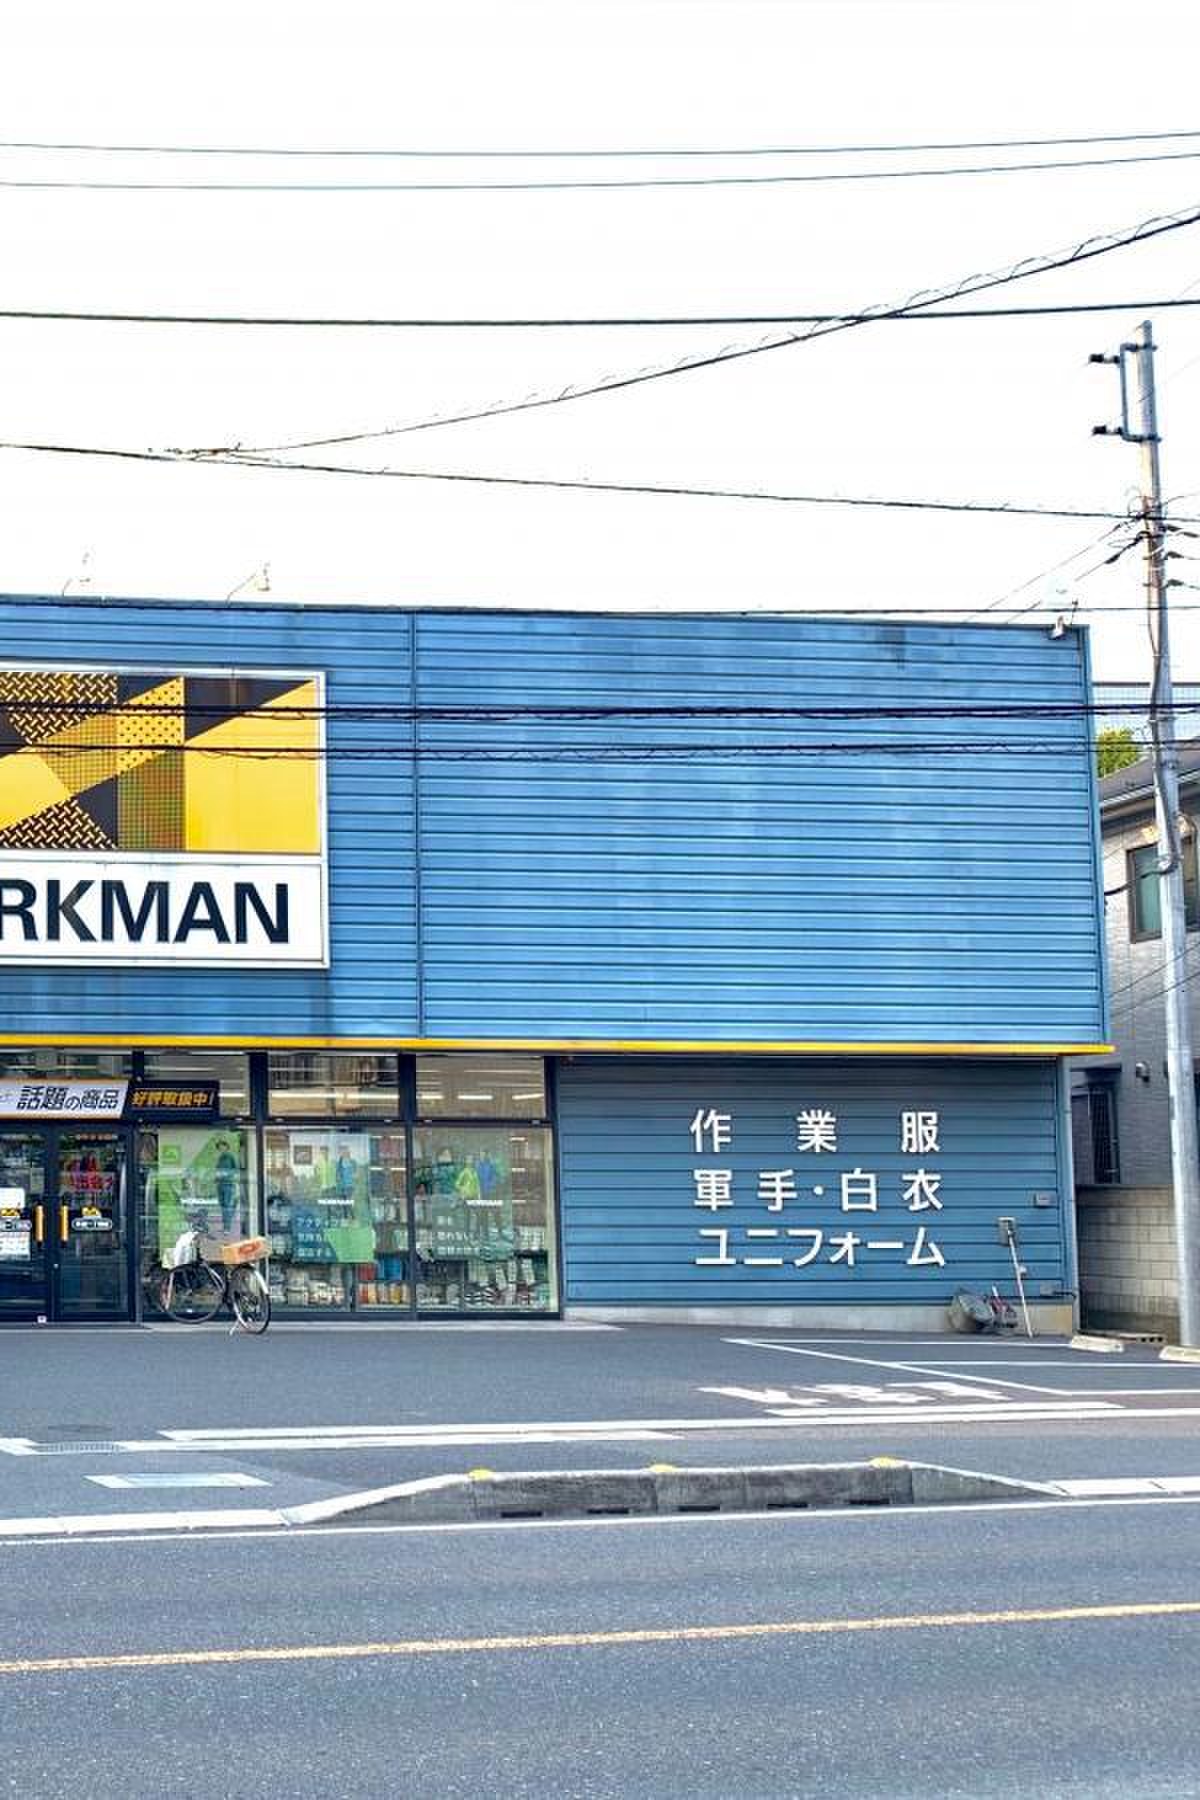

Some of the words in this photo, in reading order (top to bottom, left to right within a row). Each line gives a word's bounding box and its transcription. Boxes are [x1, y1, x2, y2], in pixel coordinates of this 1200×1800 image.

[16, 1086, 118, 1110] 話題の商品
[690, 1109, 940, 1153] 作業服
[695, 1226, 945, 1266] ユニフォーム
